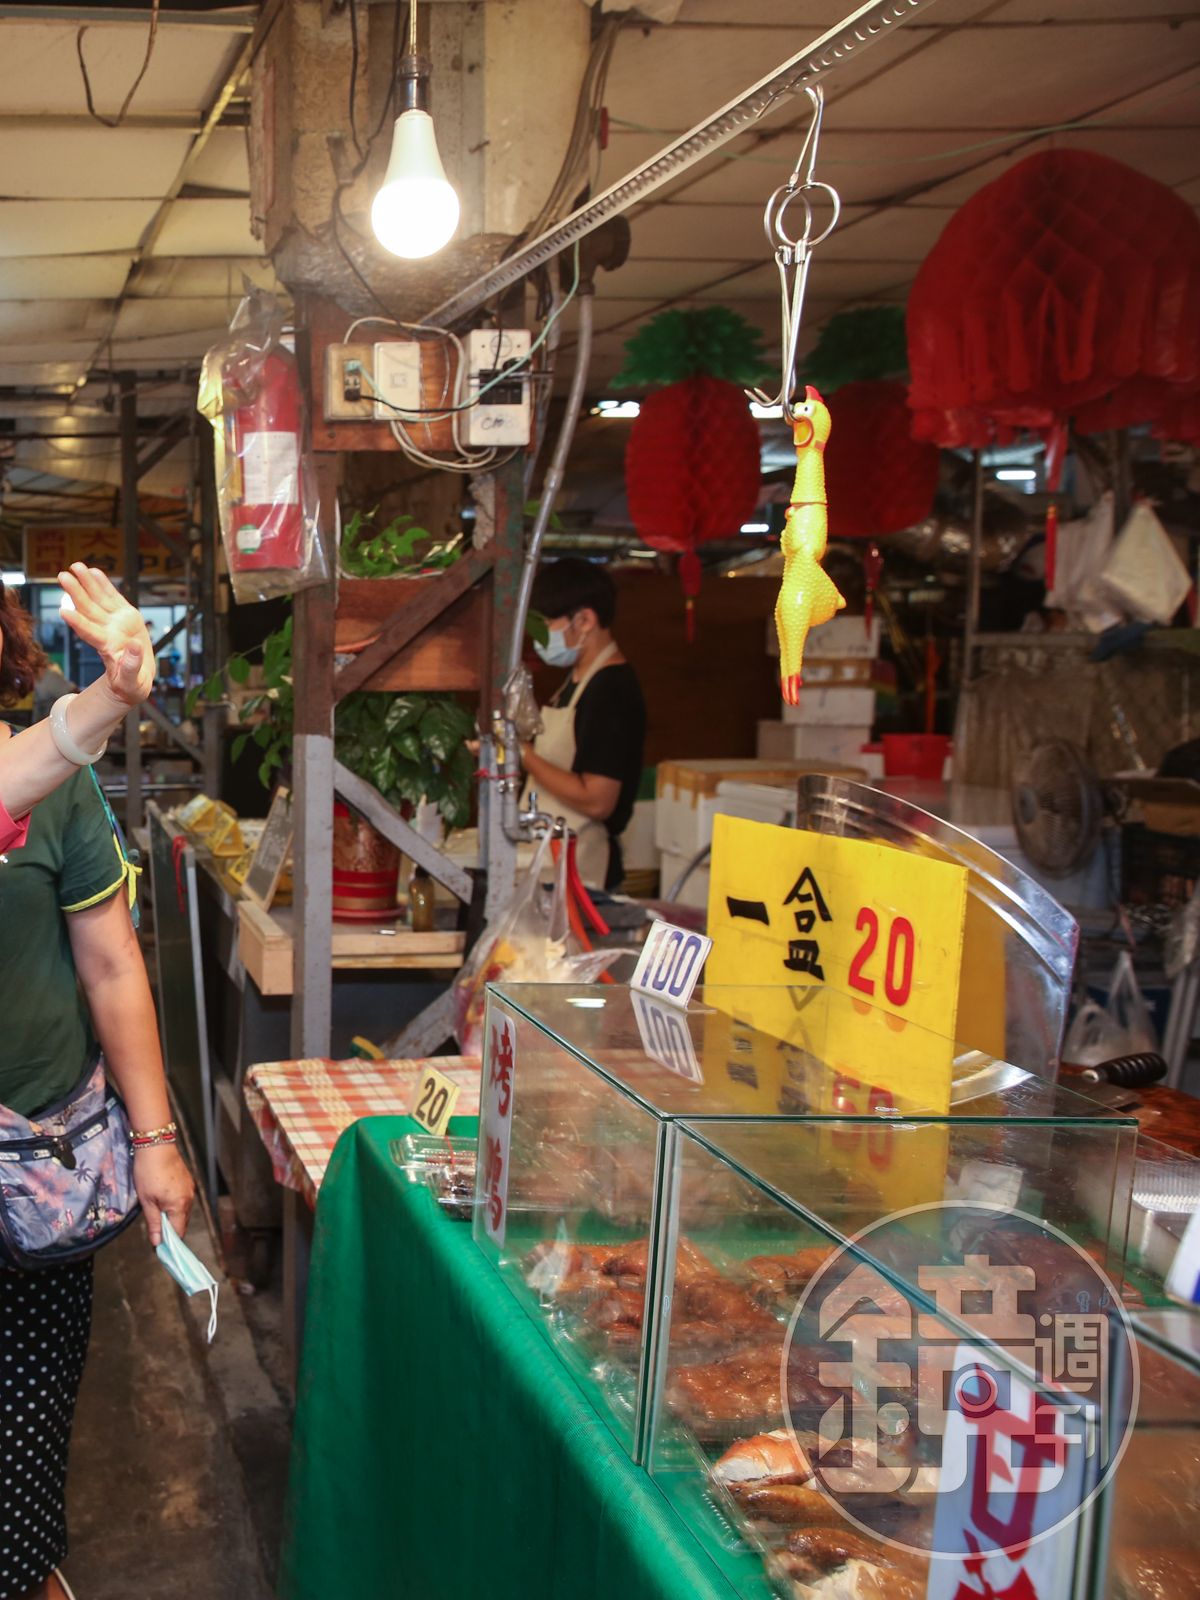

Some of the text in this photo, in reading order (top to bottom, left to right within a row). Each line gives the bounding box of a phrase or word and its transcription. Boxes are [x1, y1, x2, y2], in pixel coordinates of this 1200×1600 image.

[640, 929, 702, 998] 100
[726, 866, 915, 1007] 一盒 20
[414, 1076, 449, 1128] 20
